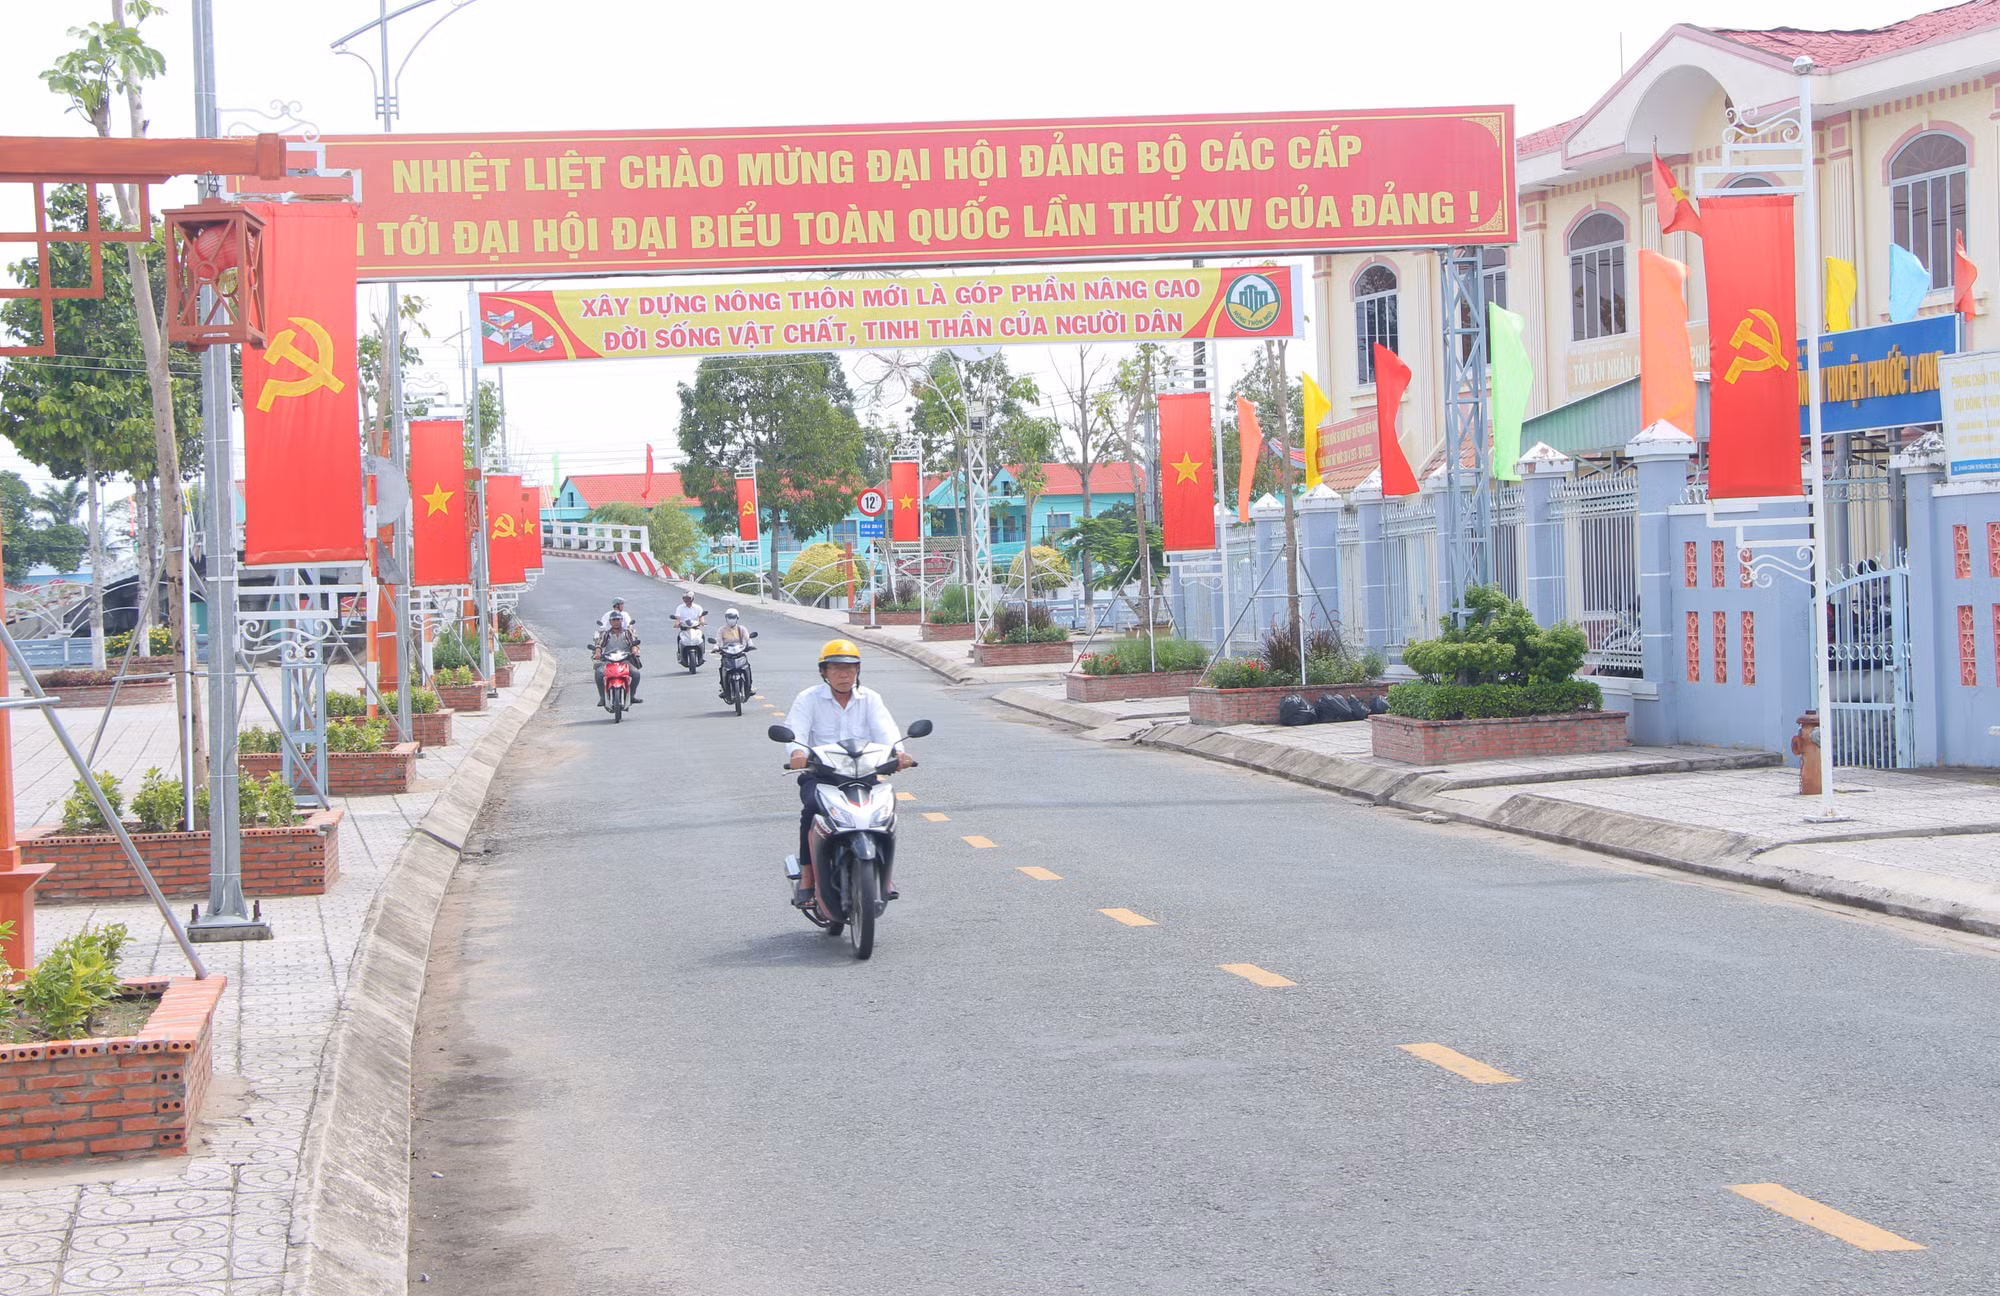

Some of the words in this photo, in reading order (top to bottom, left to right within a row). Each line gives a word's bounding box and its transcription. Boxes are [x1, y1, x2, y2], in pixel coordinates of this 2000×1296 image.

[392, 151, 511, 200] NHIỆT
[524, 149, 606, 198] LIỆT
[619, 147, 724, 190] CHÀO
[737, 144, 855, 187] MỪNG
[866, 147, 931, 189] ĐẠI
[943, 138, 1007, 187] HỘI
[1019, 131, 1124, 178] ĐẢNG
[1137, 133, 1187, 181] BỘ
[1200, 131, 1275, 172] CÁC
[1288, 124, 1362, 170] CẤP
[377, 214, 440, 256] TỚI
[453, 219, 519, 261] ĐẠI
[532, 211, 599, 259] HỘI
[611, 215, 677, 258] ĐẠI
[690, 200, 781, 249] BIỂU
[793, 203, 895, 246] TOÀN
[907, 195, 1010, 246] QUỐC
[1023, 193, 1097, 238] LẦN
[1107, 193, 1182, 235] THỨ
[1192, 198, 1253, 232] XIV
[1265, 183, 1342, 230] CỦA
[1351, 181, 1455, 227] ĐẢNG
[582, 293, 630, 317] XÂY
[639, 293, 706, 318] DỰNG
[714, 289, 781, 312] NÔNG
[788, 286, 855, 309] THÔN
[863, 283, 908, 308] MỚI
[917, 282, 947, 306] LÀ
[955, 280, 1003, 304] GÓP
[1012, 275, 1076, 303] PHẦN
[1084, 277, 1148, 300] NÂNG
[1154, 278, 1201, 299] CAO
[604, 325, 647, 351] ĐỜI
[655, 320, 721, 349] SỐNG
[727, 320, 775, 349] VẬT
[783, 315, 856, 346] CHẤT,
[863, 319, 919, 341] TINH
[927, 310, 992, 338] THẦN
[1000, 309, 1048, 336] CỦA
[1056, 306, 1126, 334] NGƯỜI
[1135, 307, 1183, 333] DÂN
[1827, 353, 1867, 408] HUYỆN
[1867, 344, 1909, 398] PHƯỚC
